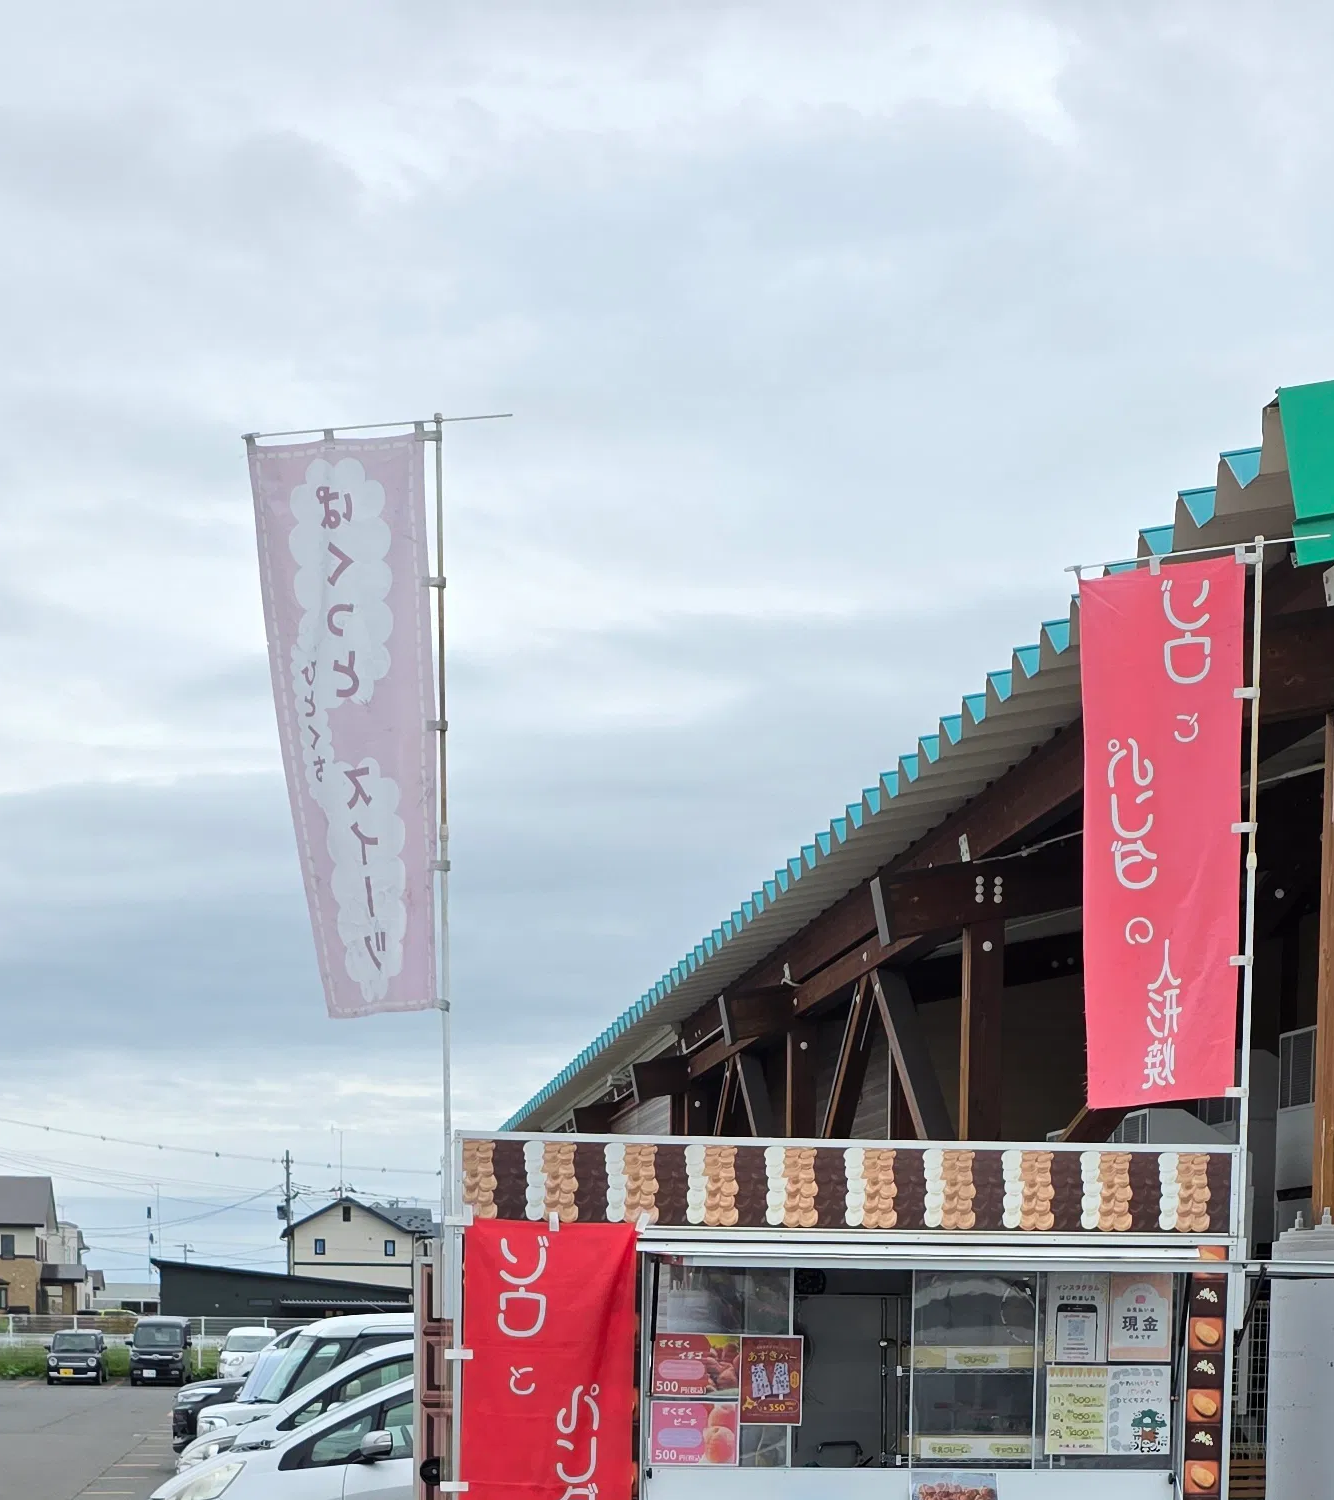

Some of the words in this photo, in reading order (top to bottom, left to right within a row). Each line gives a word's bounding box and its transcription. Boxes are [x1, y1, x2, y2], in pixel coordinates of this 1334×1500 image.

[1122, 1316, 1158, 1331] 現金
[678, 1352, 704, 1360] イチゴ
[747, 1351, 798, 1362] あずきバー
[655, 1381, 678, 1392] 500
[769, 1403, 785, 1411] 350
[673, 1418, 697, 1426] ピーチ
[654, 1450, 677, 1461] 500
